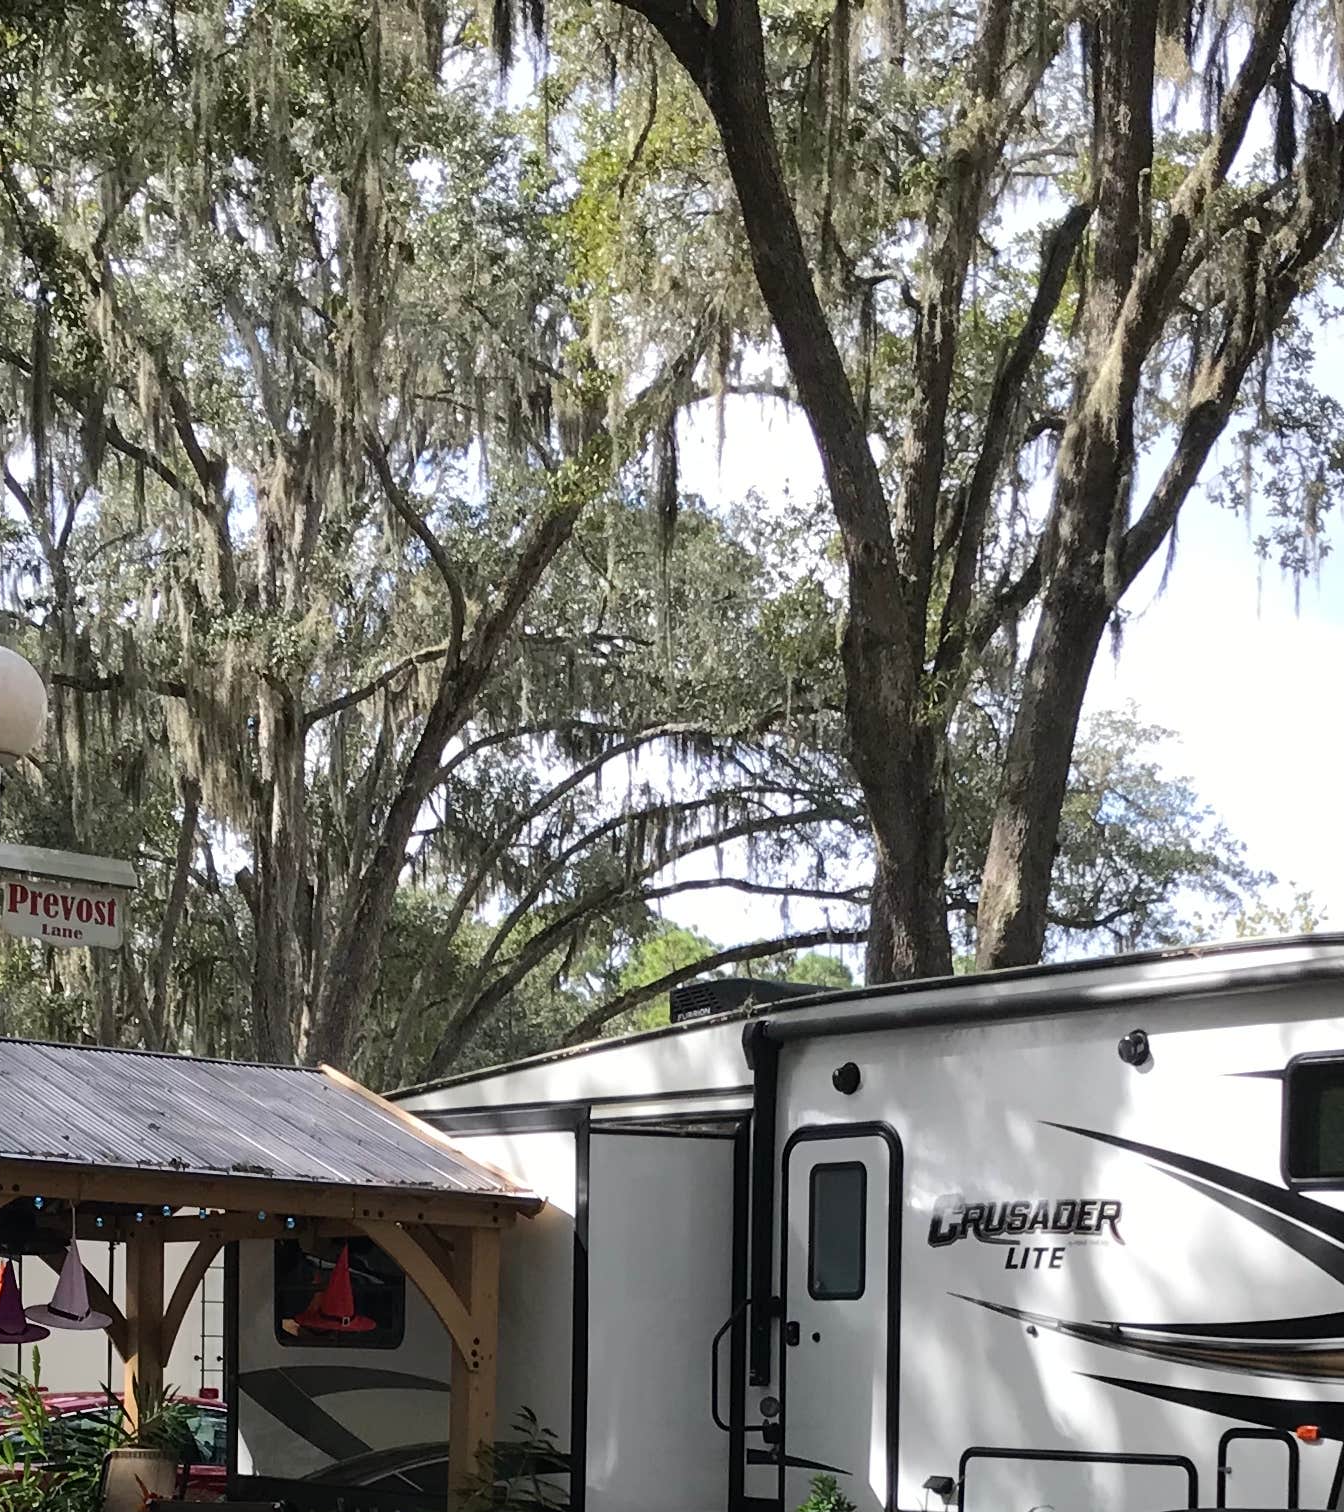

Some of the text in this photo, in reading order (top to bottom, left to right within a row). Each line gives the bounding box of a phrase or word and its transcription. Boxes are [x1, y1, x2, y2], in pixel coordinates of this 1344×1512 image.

[8, 883, 116, 927] Prevost
[41, 923, 83, 939] Lane
[927, 1193, 1125, 1248] CRUSADER
[1005, 1247, 1066, 1270] LITE
